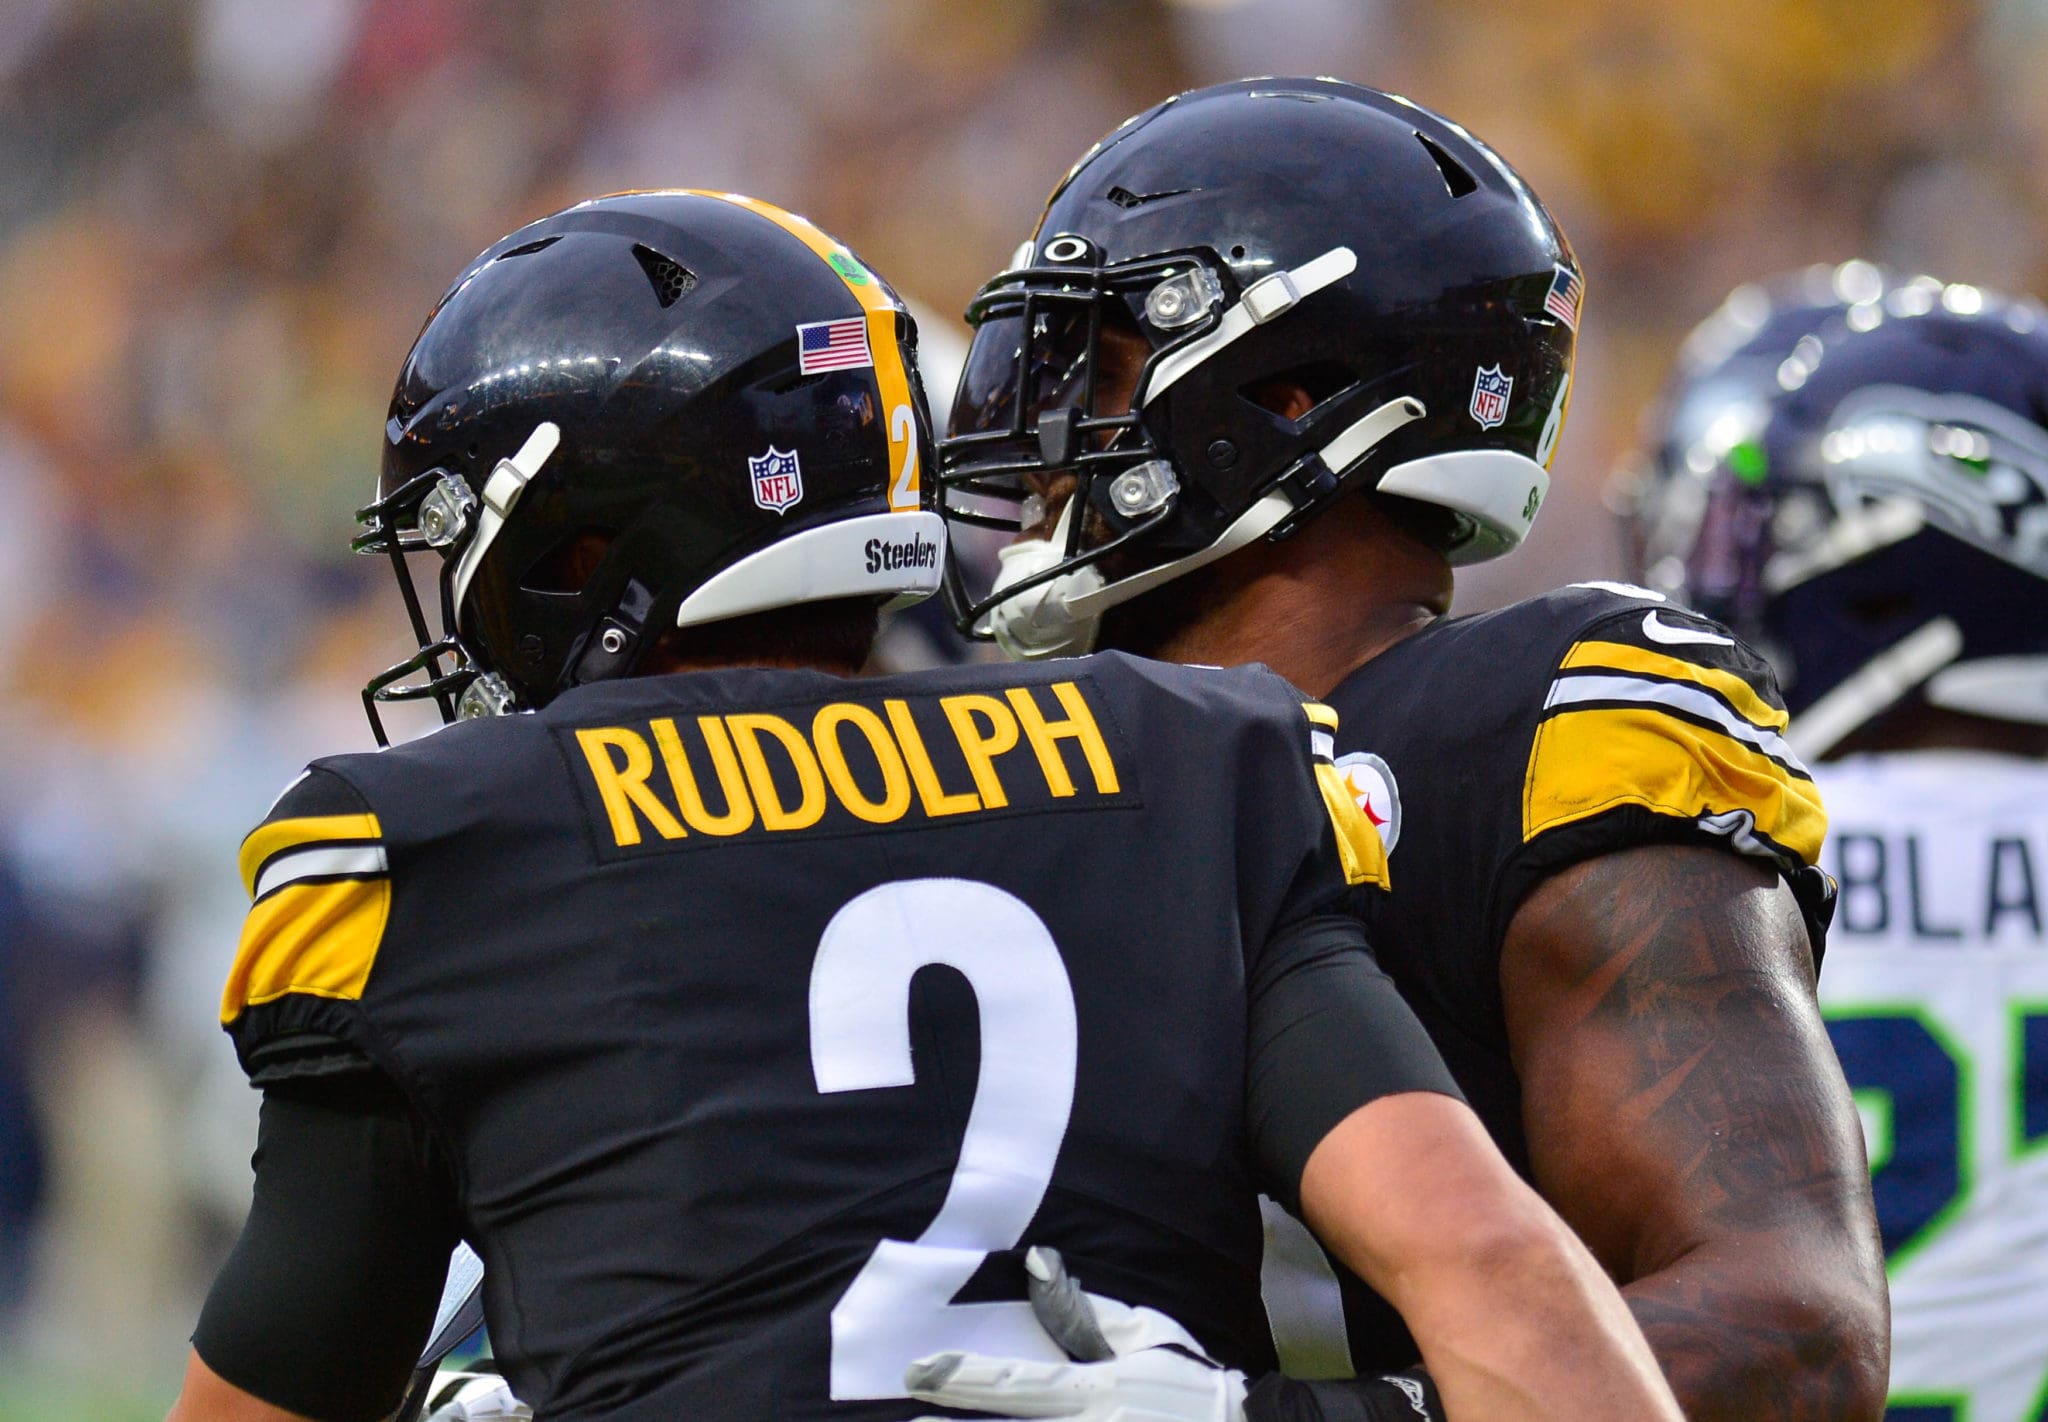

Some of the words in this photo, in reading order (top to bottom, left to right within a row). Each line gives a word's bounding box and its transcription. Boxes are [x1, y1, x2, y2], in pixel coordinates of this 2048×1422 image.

[1475, 391, 1504, 420] NFL
[759, 475, 796, 503] NFL
[891, 404, 920, 508] 2
[864, 532, 937, 574] Steelers
[575, 682, 1121, 847] RUDOLPH
[809, 878, 1078, 1402] 2
